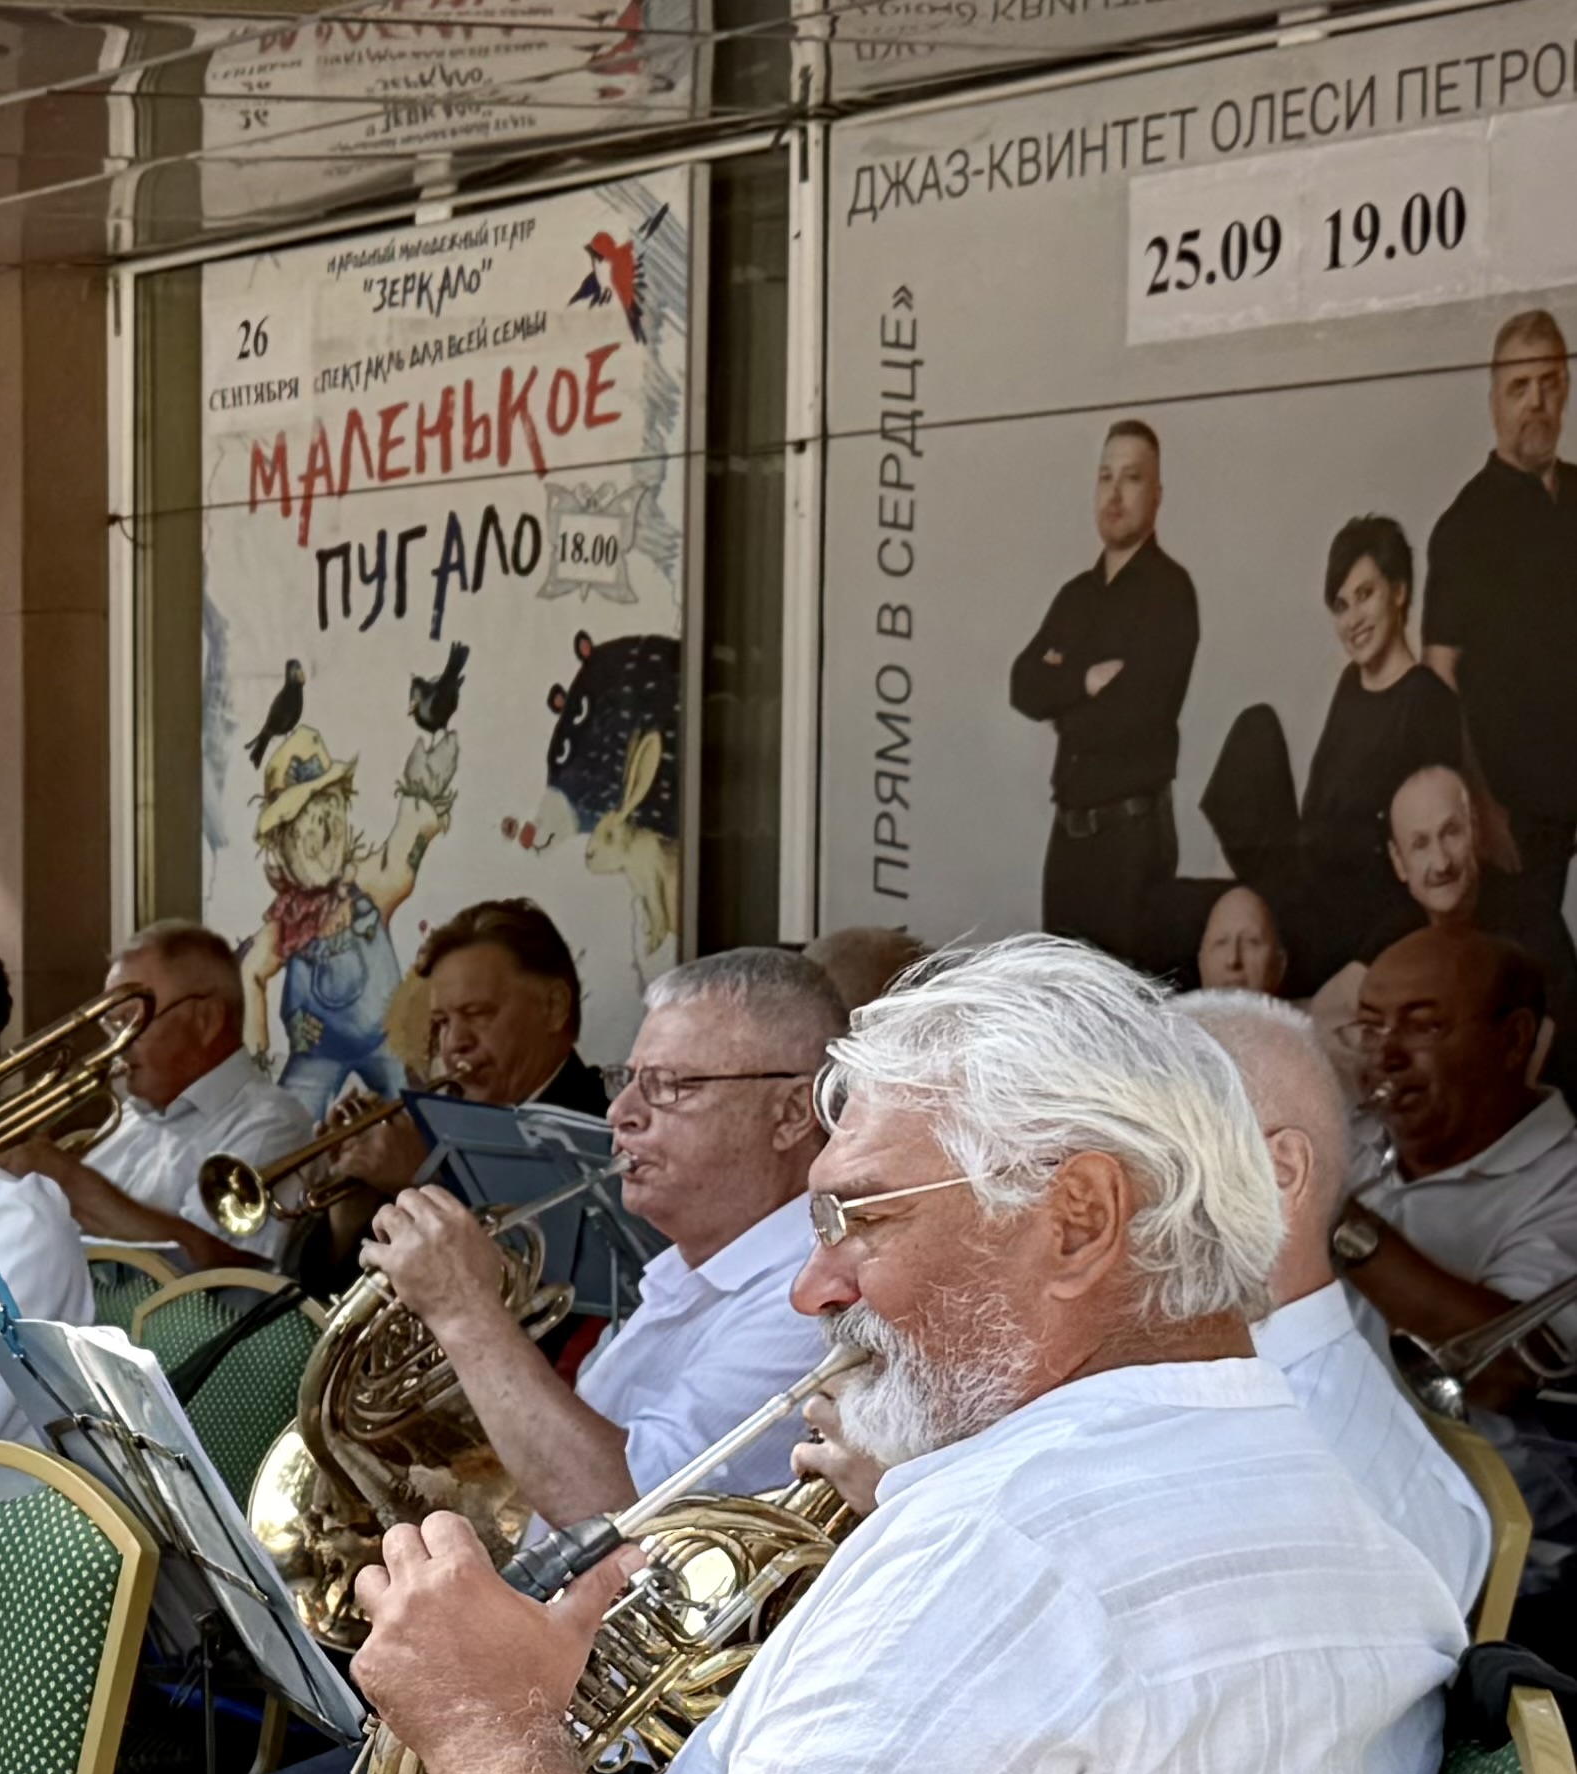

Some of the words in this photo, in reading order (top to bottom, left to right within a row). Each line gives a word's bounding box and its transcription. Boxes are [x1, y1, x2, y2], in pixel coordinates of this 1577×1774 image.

[848, 107, 1199, 226] ДЖАЗ-КВИНТЕТ
[1210, 74, 1378, 154] ОЛЕСИ
[1395, 39, 1577, 122] ПЕТРО
[493, 217, 537, 250] ТЕАТР
[1144, 213, 1283, 298] 25.09
[1323, 185, 1468, 273] 19.00
[363, 257, 493, 318] "ЗЕРКАЛО"
[236, 315, 270, 361] 26
[313, 350, 406, 393] СПЕКТАКЛЬ
[409, 338, 444, 370] ДЛЯ
[447, 317, 488, 359] ВСЕЙ
[492, 311, 547, 348] СЕМЬИ
[209, 376, 300, 412] СЕНТЯБРЯ
[877, 283, 926, 578] СЕРДЦЕ»
[249, 342, 622, 548] МАЛЕНЬКОЕ
[315, 503, 543, 642] ПУГАЛО
[560, 530, 619, 568] 18.00
[876, 602, 914, 640] В
[872, 664, 913, 901] ПРЯМО
